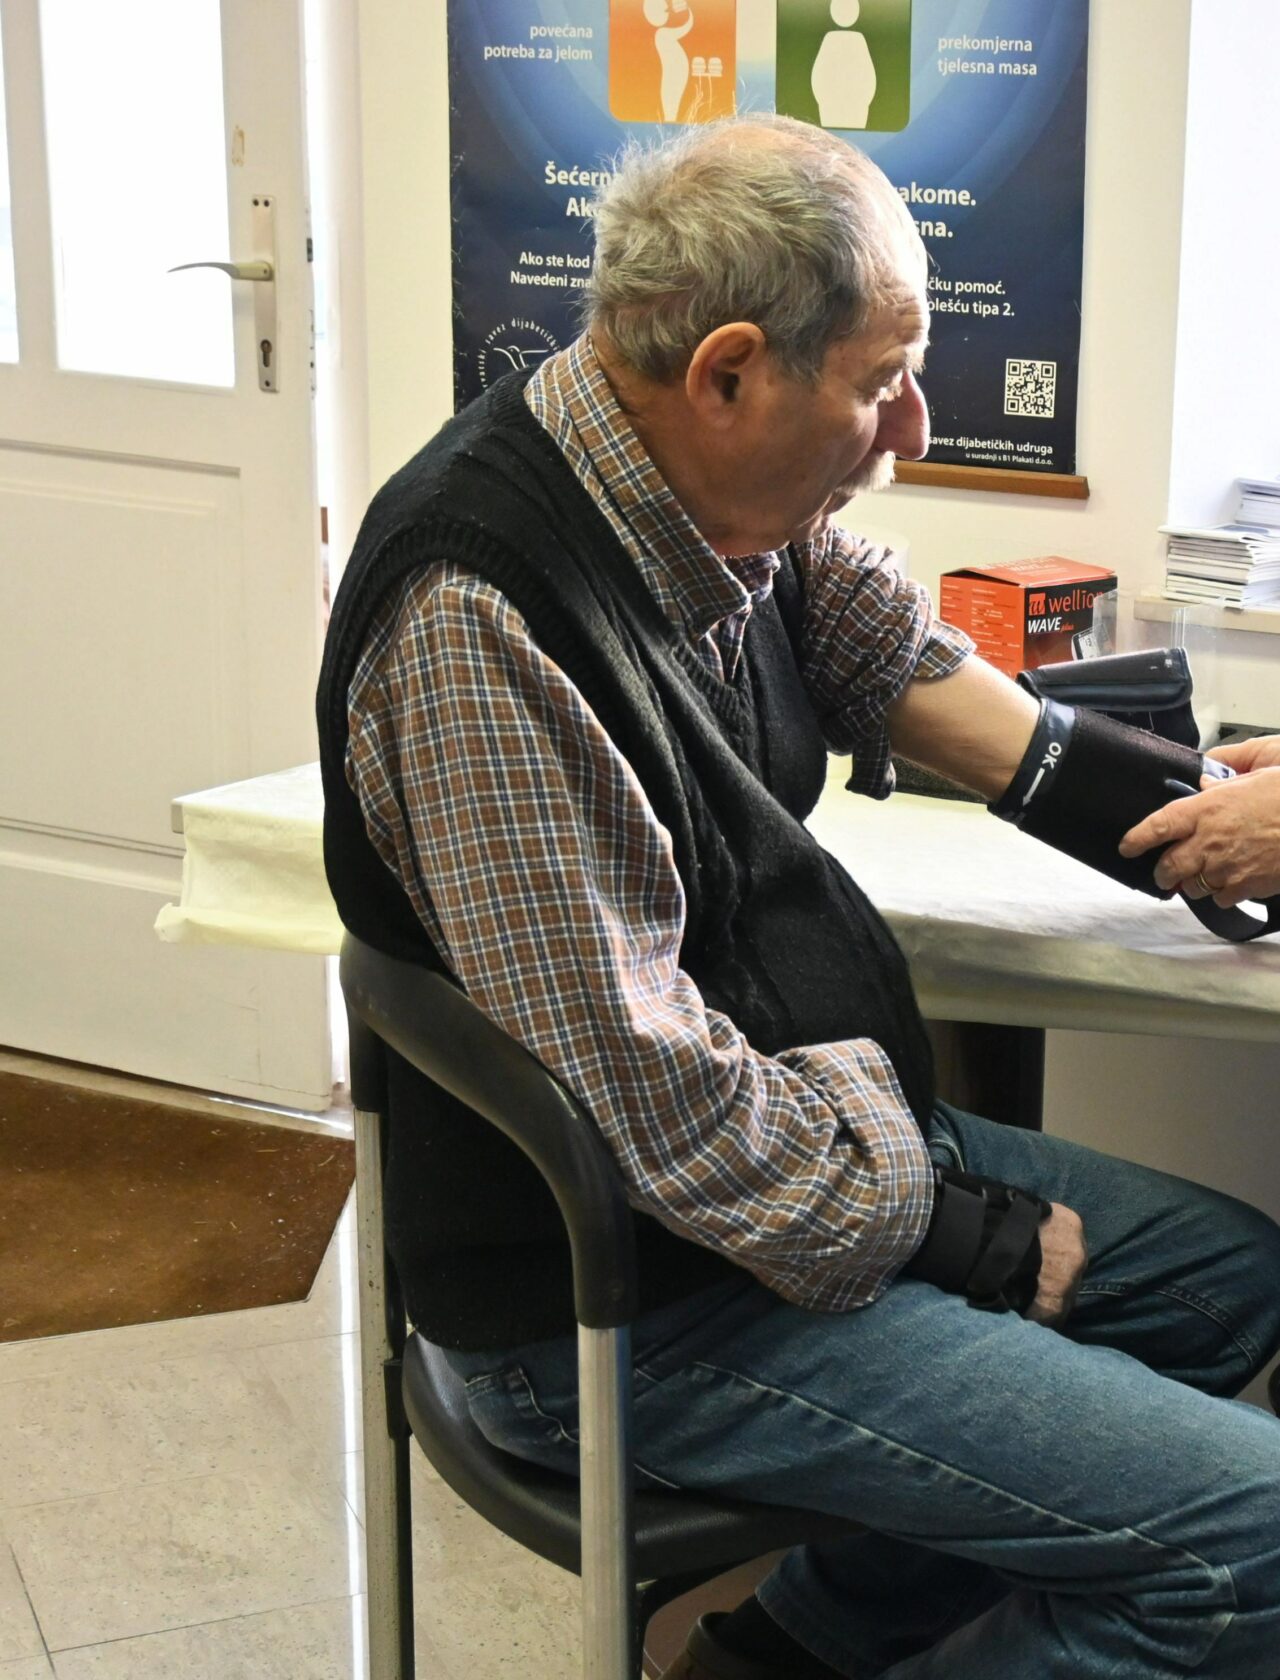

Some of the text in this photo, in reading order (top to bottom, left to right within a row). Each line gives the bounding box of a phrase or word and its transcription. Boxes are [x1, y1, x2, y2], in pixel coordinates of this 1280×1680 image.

[530, 24, 593, 40] povećana
[484, 44, 593, 63] potreba za jelom
[938, 34, 1033, 55] prekomjerna
[938, 58, 1037, 76] tjelesna masa
[545, 160, 622, 187] Šećern
[894, 181, 977, 206] akome.
[519, 251, 590, 269] Ako ste kod
[510, 271, 568, 287] Navedeni
[955, 280, 1006, 295] pomoć.
[972, 300, 999, 318] tipa
[1002, 303, 1015, 317] 2.
[956, 436, 1014, 451] dijabetičkih
[1016, 441, 1053, 456] udruga
[1027, 616, 1063, 634] WAVE
[1041, 741, 1062, 770] OK
